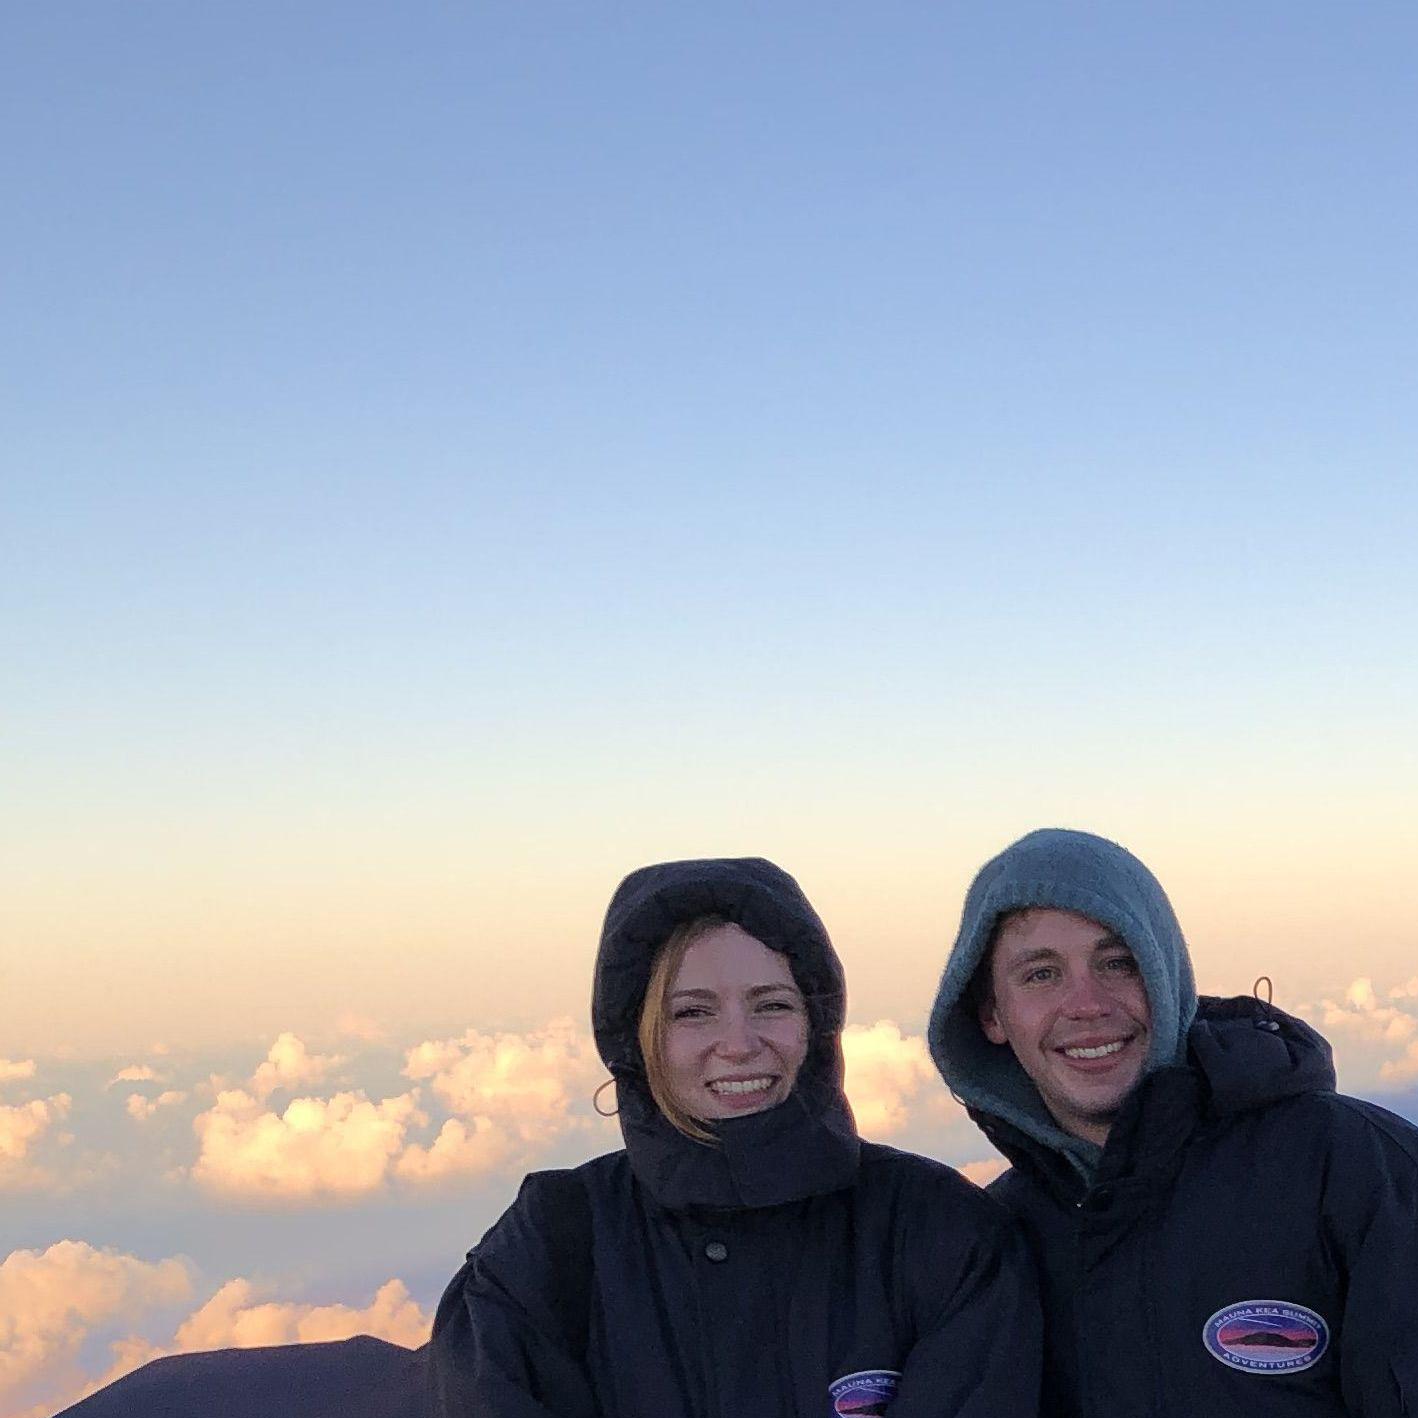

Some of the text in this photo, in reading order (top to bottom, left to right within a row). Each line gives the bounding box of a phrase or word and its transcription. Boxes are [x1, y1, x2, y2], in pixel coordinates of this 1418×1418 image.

[1214, 1308, 1252, 1328] MAUNA
[1282, 1309, 1321, 1329] SUMMIT
[1222, 1353, 1312, 1369] ADVENTURES
